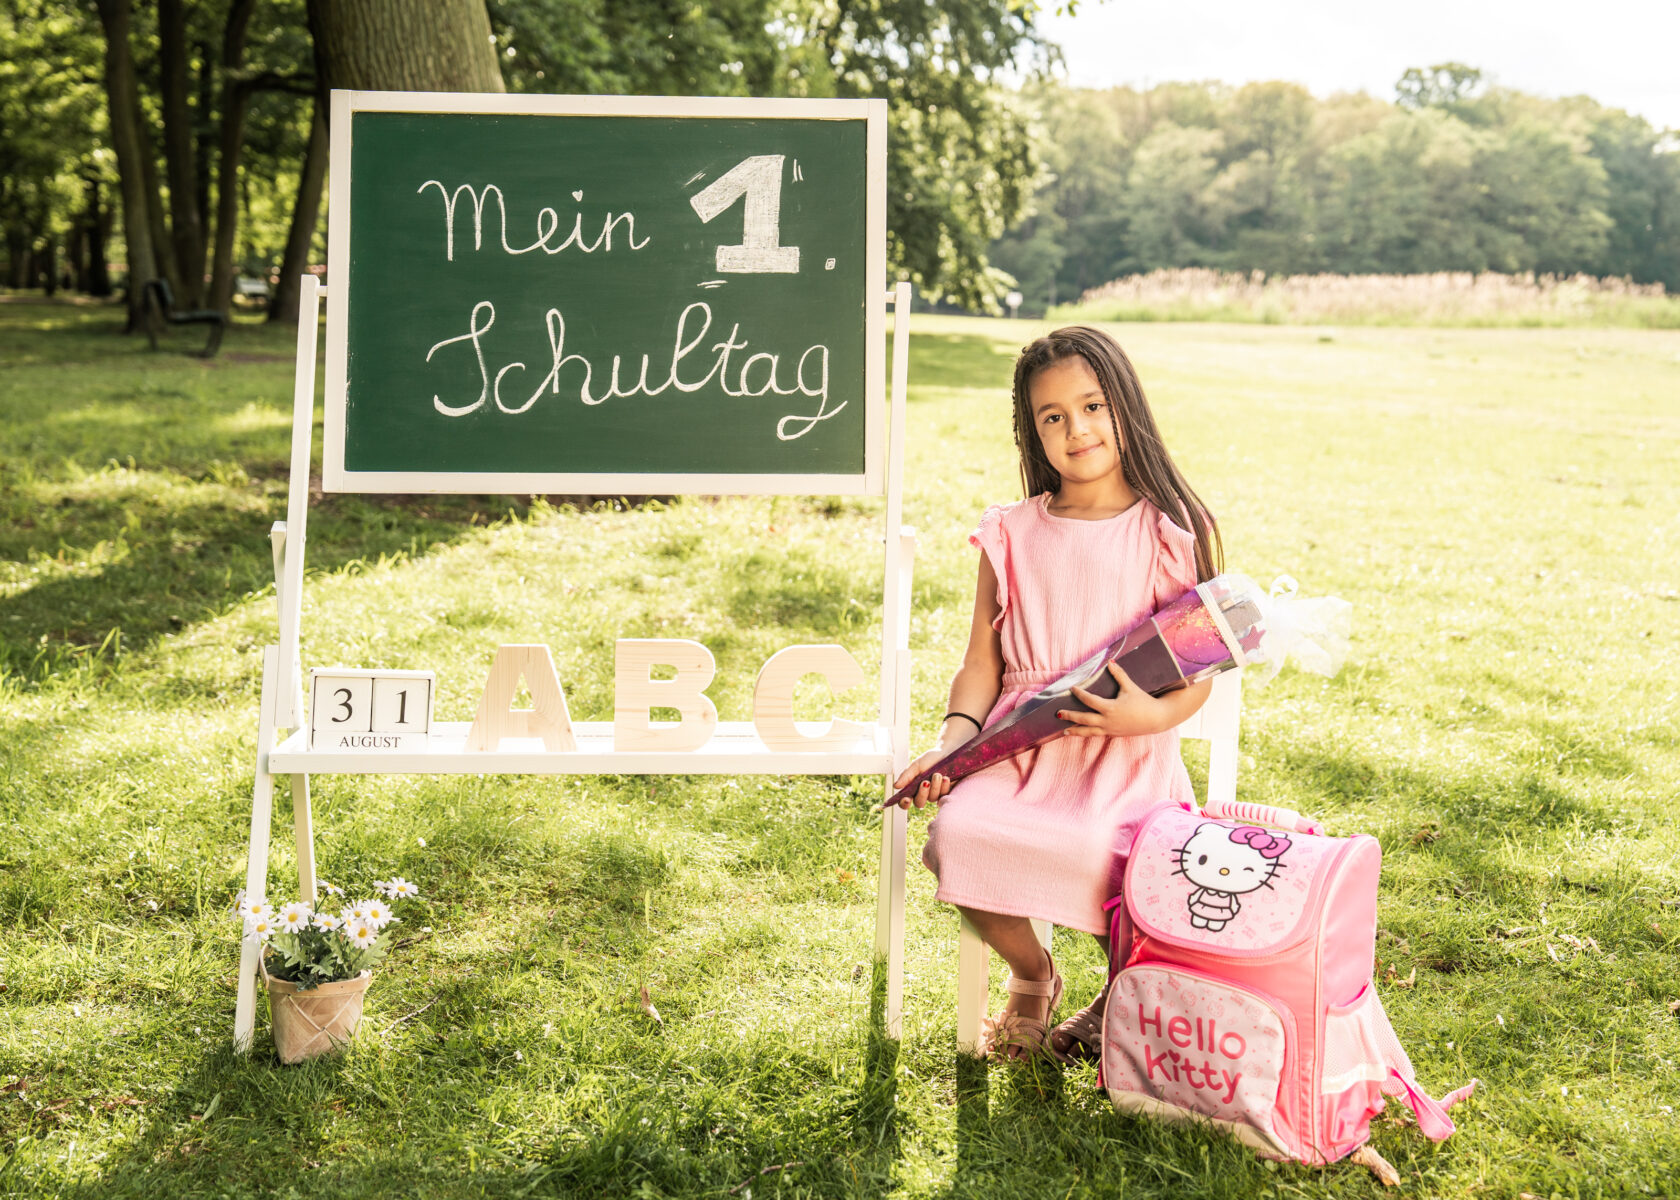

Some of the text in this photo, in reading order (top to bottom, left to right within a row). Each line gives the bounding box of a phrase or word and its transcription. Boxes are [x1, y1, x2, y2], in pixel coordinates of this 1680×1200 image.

[417, 180, 651, 261] Mein
[426, 301, 848, 441] Schultag
[339, 735, 402, 749] AUGUST
[1138, 1002, 1247, 1060] Hello
